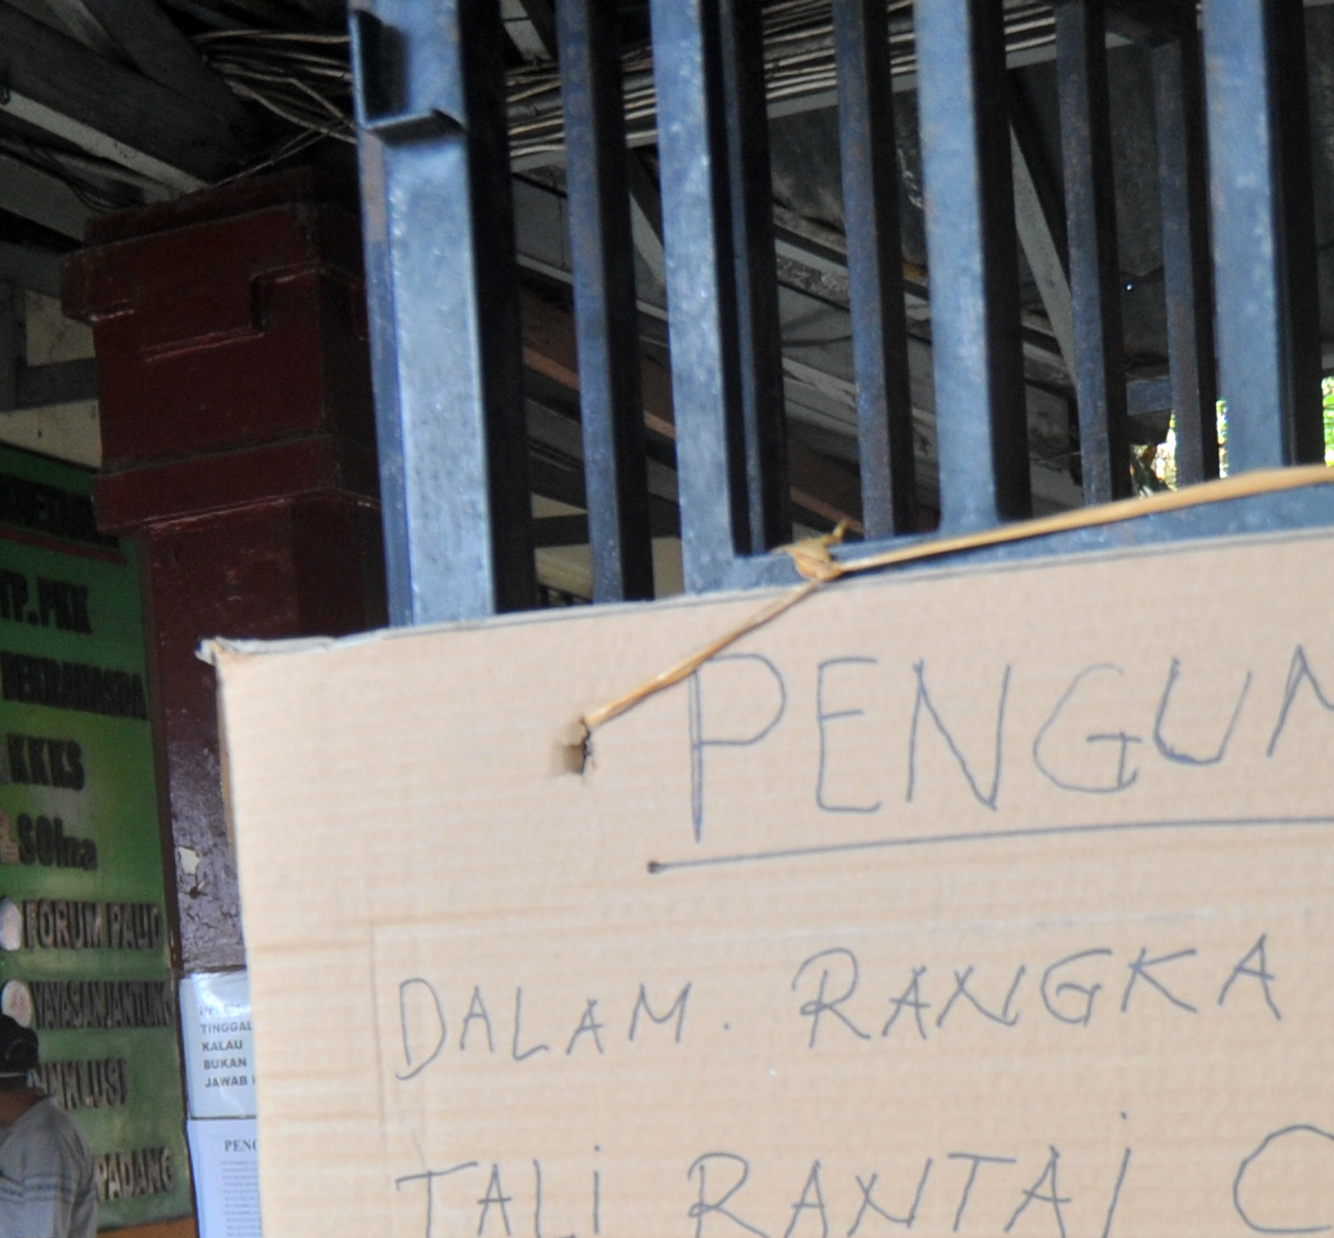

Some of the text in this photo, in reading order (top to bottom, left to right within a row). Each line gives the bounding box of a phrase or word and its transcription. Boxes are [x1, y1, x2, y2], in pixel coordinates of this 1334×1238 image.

[22, 898, 101, 951] FORUM
[791, 933, 1283, 1049] RANGKA
[202, 1039, 243, 1052] KALAU
[203, 1057, 248, 1071] BUKAN
[204, 1076, 248, 1089] JAWAB
